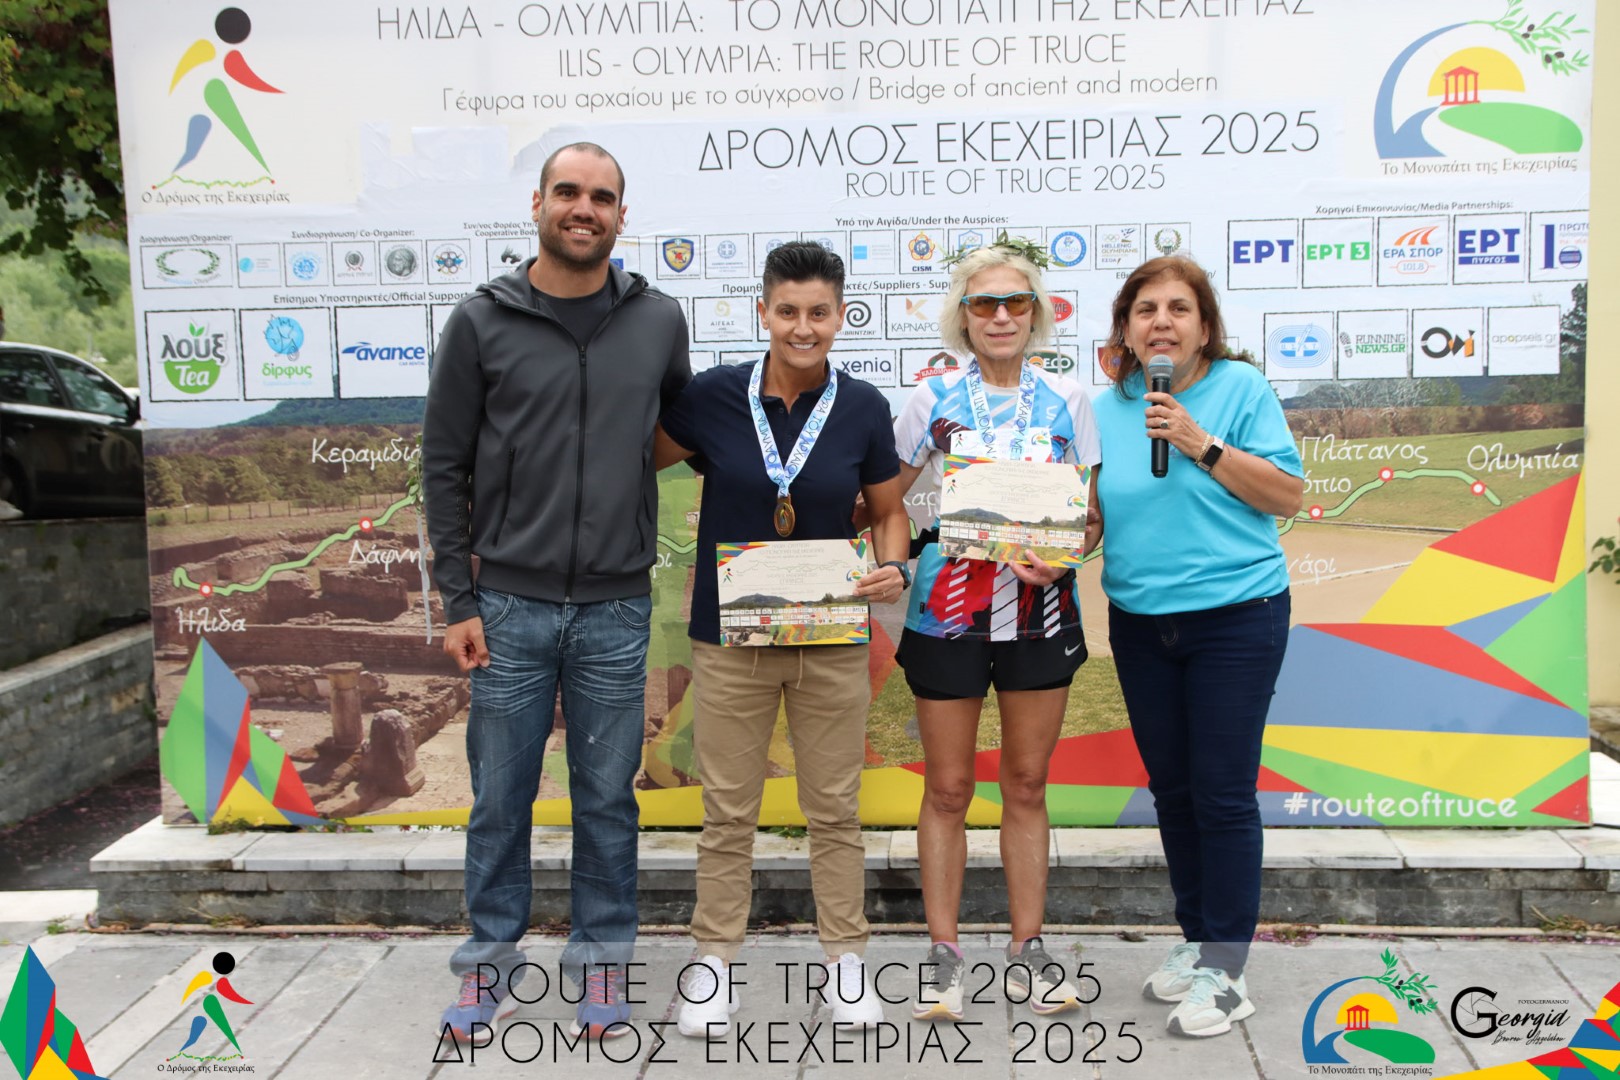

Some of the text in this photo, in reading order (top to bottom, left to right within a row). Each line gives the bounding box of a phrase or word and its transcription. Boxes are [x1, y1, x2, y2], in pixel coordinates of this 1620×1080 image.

[377, 6, 483, 40] ΗΛΙΔΑ
[518, 1, 703, 38] ΟΛΥΜΠΙΑ:
[729, 0, 780, 31] ΤΟ
[559, 48, 602, 78] ILIS
[632, 43, 781, 77] OLYMPIA:
[792, 41, 846, 72] THE
[859, 37, 960, 69] ROUTE
[972, 36, 1016, 66] OF
[1028, 33, 1127, 65] TRUCE
[442, 88, 525, 115] Γέφυρα
[532, 93, 567, 109] του
[575, 86, 663, 113] αρχαίου
[672, 92, 697, 111] με
[706, 90, 727, 105] το
[735, 83, 843, 110] σύγχρονο
[869, 76, 945, 105] Bridge
[953, 73, 976, 98] of
[985, 74, 1068, 97] ancient
[1076, 70, 1122, 95] and
[1129, 68, 1218, 93] modern
[698, 110, 1320, 171] ΔΡΟΜΟΣ ΕΚΕΧΕΙΡΙΑΣ 2025
[1380, 156, 1579, 176] Το Μονοπάτι της Εκεχειρίας
[846, 163, 1166, 199] ROUTE OF TRUCE 2025
[156, 191, 201, 206] Δρόμος
[203, 192, 224, 206] της
[227, 190, 291, 206] Εκεχειρίας
[1315, 200, 1514, 216] Χορηγοί Επικοινωνίας/Media Partnerships:
[835, 214, 1009, 229] Υπό την Αιγίδα/Under the Auspices:
[360, 229, 415, 239] Co-Organizer:
[475, 228, 539, 238] Cooperative Body
[1458, 228, 1520, 254] ΕΡΤ
[1233, 239, 1294, 264] ΕΡΤ
[1306, 243, 1367, 261] ΕΡΤ 3
[1383, 247, 1443, 259] ΕΡΑ ΣΠΟΡ
[1471, 256, 1507, 265] ΠΥΡΓΟΣ
[274, 294, 317, 305] Επίσημοι
[891, 322, 940, 332] ΚΑΡΝΑΡΟ
[1356, 333, 1405, 344] RUNNING
[356, 345, 425, 362] avance
[1356, 343, 1405, 354] NEWS.GR
[841, 356, 892, 373] xenia
[175, 365, 210, 387] Tea
[1302, 434, 1429, 464] Πλάτανος
[1467, 443, 1580, 478] Ολυμπία
[1303, 470, 1352, 494] όπιο
[348, 539, 424, 573] Δάφνη
[1283, 791, 1519, 818] #routeoftruce
